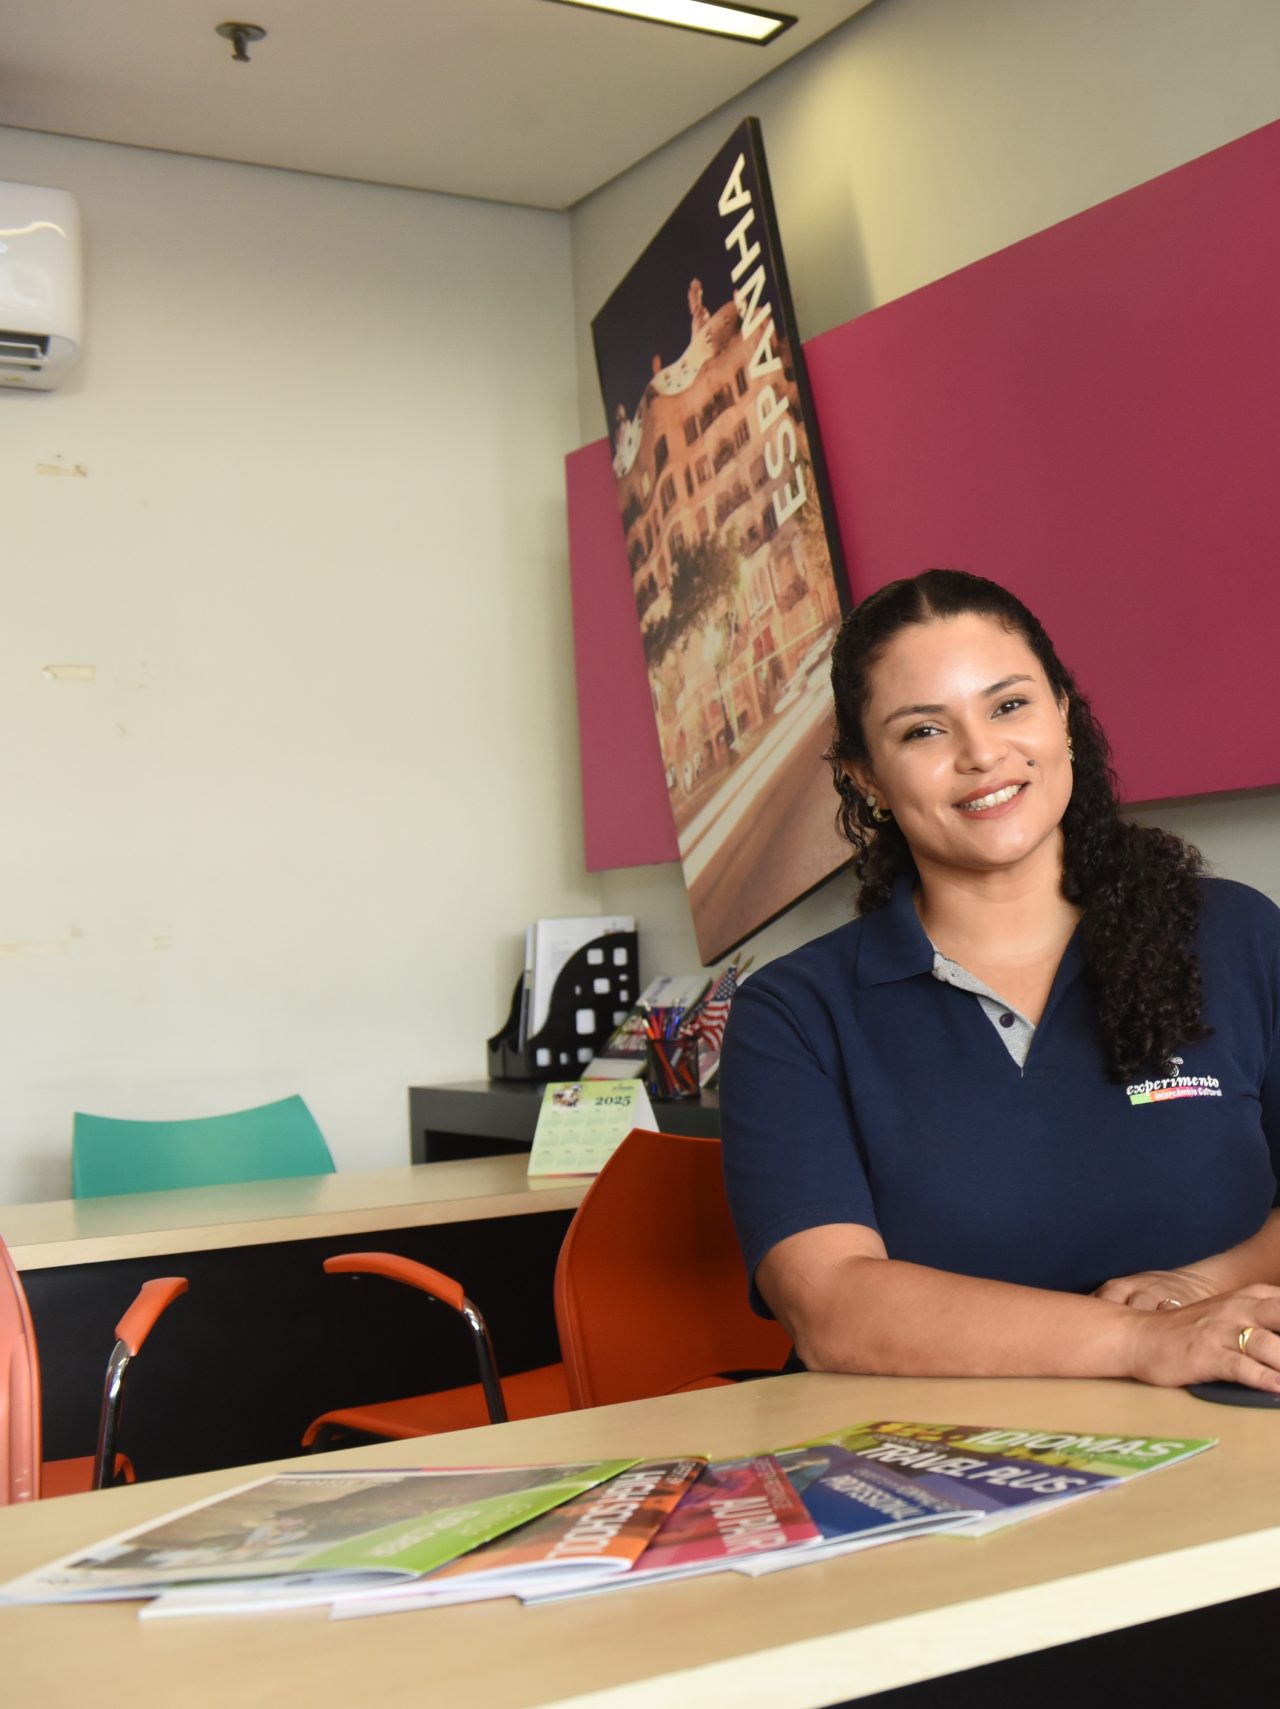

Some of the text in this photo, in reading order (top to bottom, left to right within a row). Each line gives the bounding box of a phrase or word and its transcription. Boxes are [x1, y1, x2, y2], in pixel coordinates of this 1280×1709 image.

[717, 152, 807, 527] ESPANHA
[1126, 1075, 1220, 1097] experimento
[595, 1096, 631, 1106] 2025
[963, 1430, 1185, 1457] IDIOMAS
[856, 1443, 988, 1480] TRAVEL
